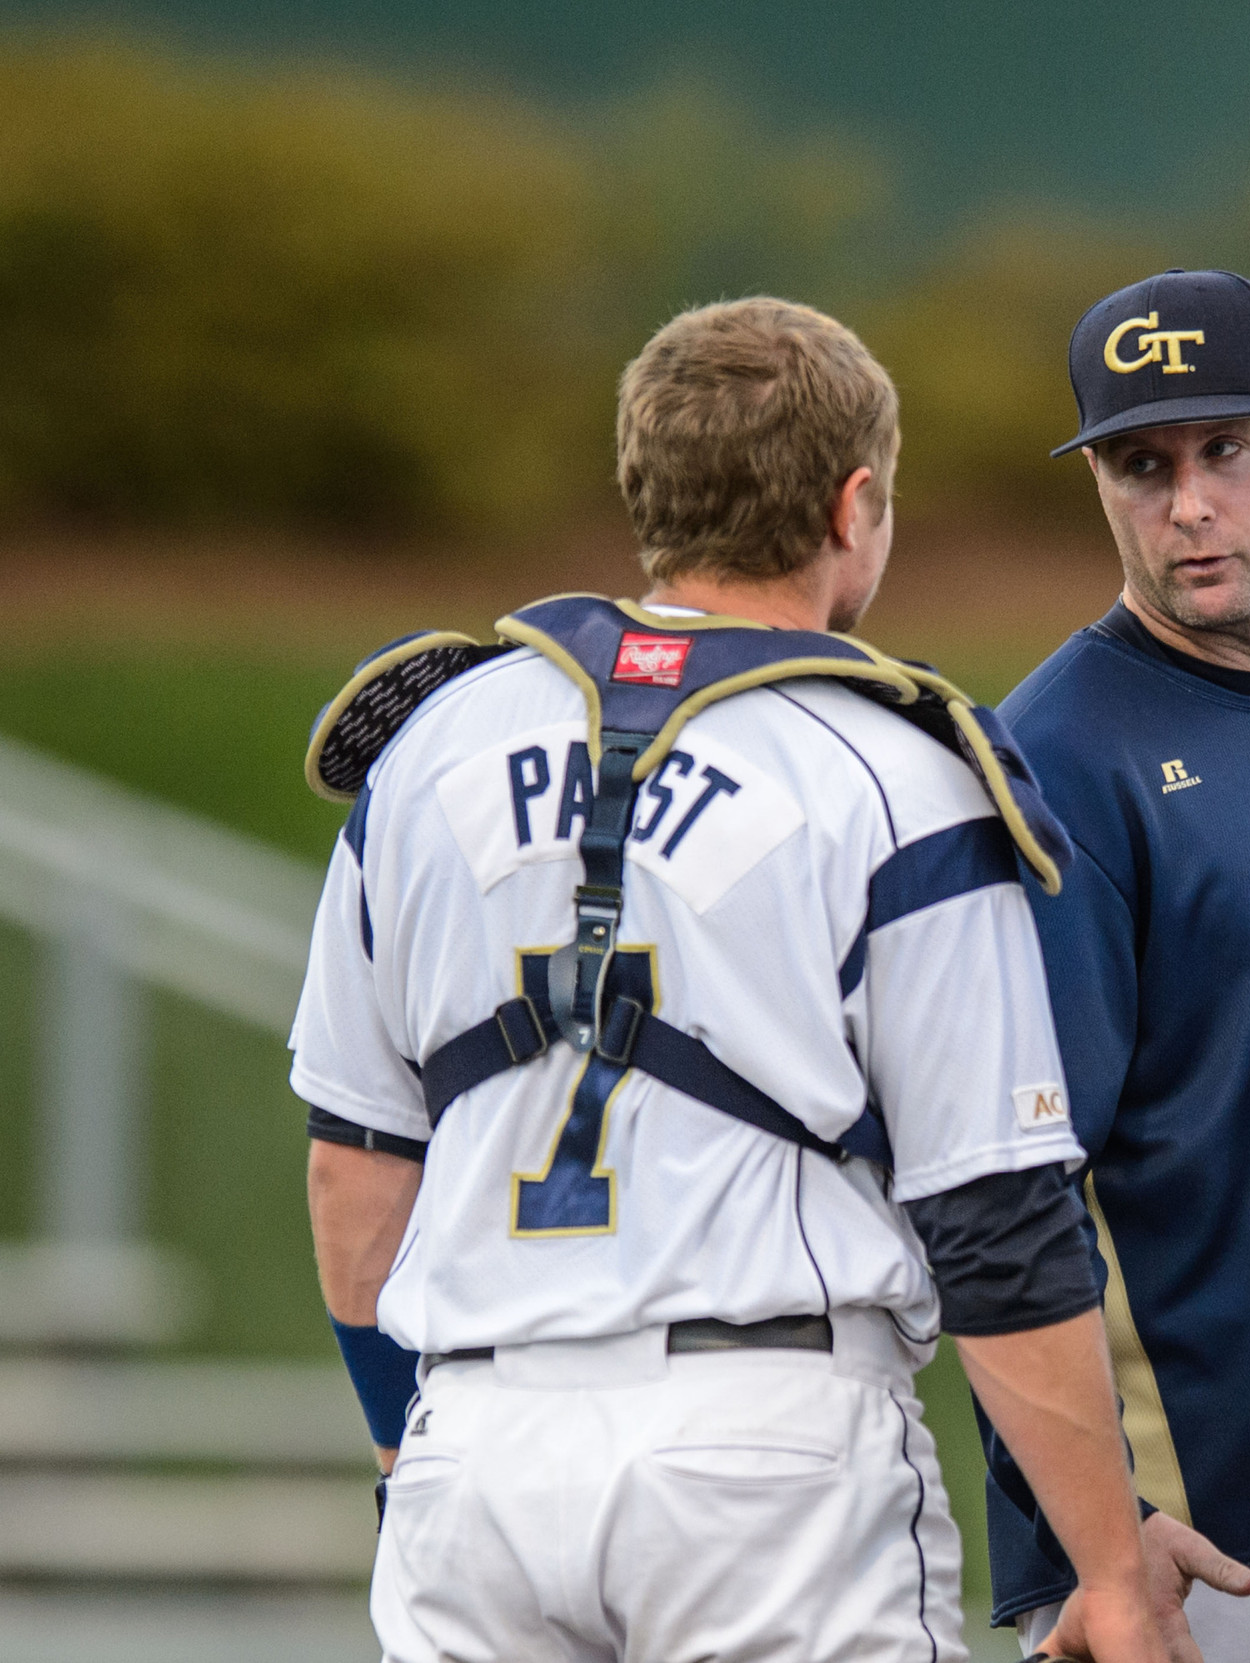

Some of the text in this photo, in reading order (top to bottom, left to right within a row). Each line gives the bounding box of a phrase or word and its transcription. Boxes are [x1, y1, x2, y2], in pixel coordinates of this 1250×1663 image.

[1104, 311, 1205, 374] GT
[507, 741, 742, 860] PAST
[1162, 775, 1203, 795] RUSSELL
[578, 1026, 591, 1045] 7
